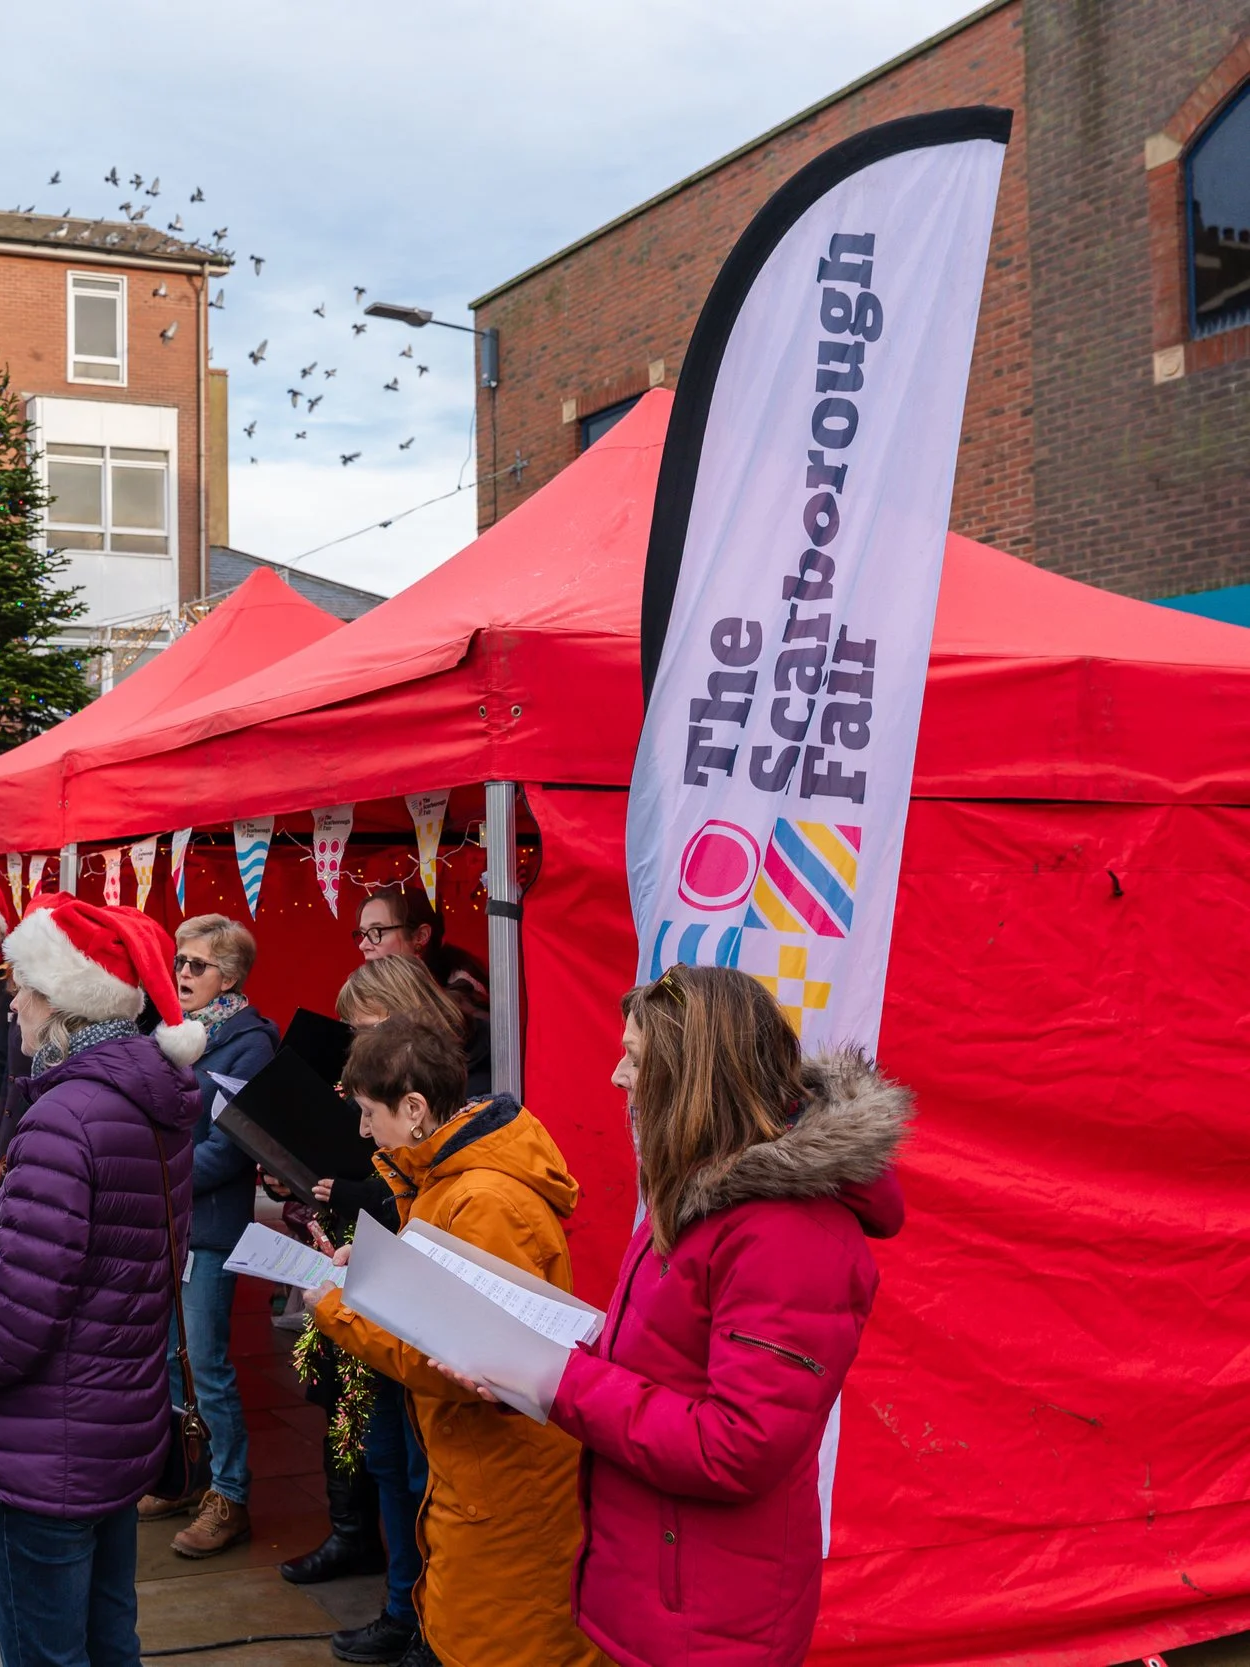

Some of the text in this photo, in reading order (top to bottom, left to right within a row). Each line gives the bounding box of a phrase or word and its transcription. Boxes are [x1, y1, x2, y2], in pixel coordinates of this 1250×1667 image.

[749, 232, 884, 793] Scarborough
[683, 617, 763, 787] The
[800, 624, 877, 804] Fair
